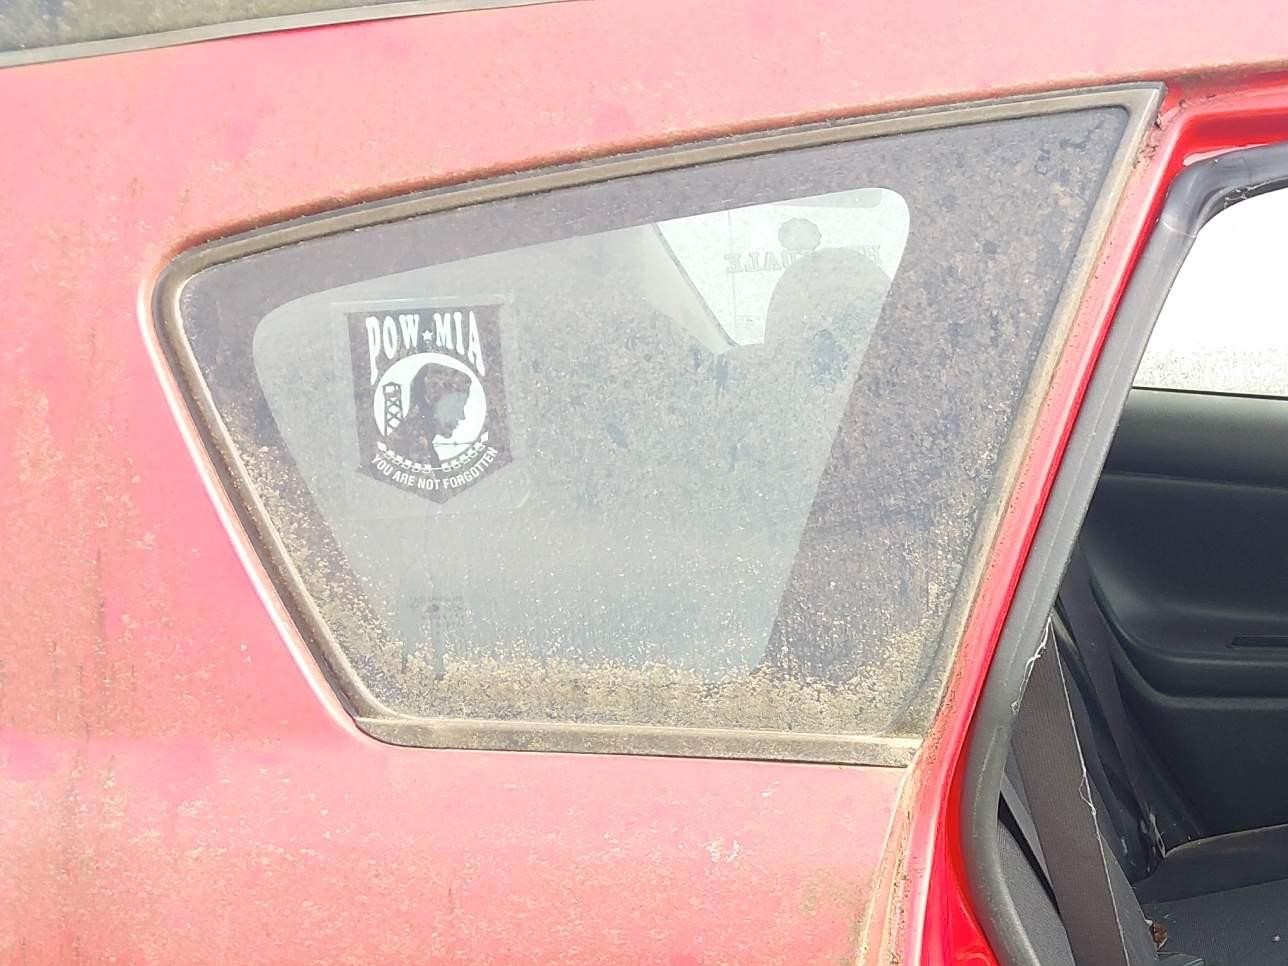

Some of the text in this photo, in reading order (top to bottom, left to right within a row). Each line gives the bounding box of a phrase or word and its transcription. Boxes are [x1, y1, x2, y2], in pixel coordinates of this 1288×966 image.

[365, 311, 486, 386] POW MIA
[370, 446, 499, 491] YOU ARE NOT FORGOTTEN
